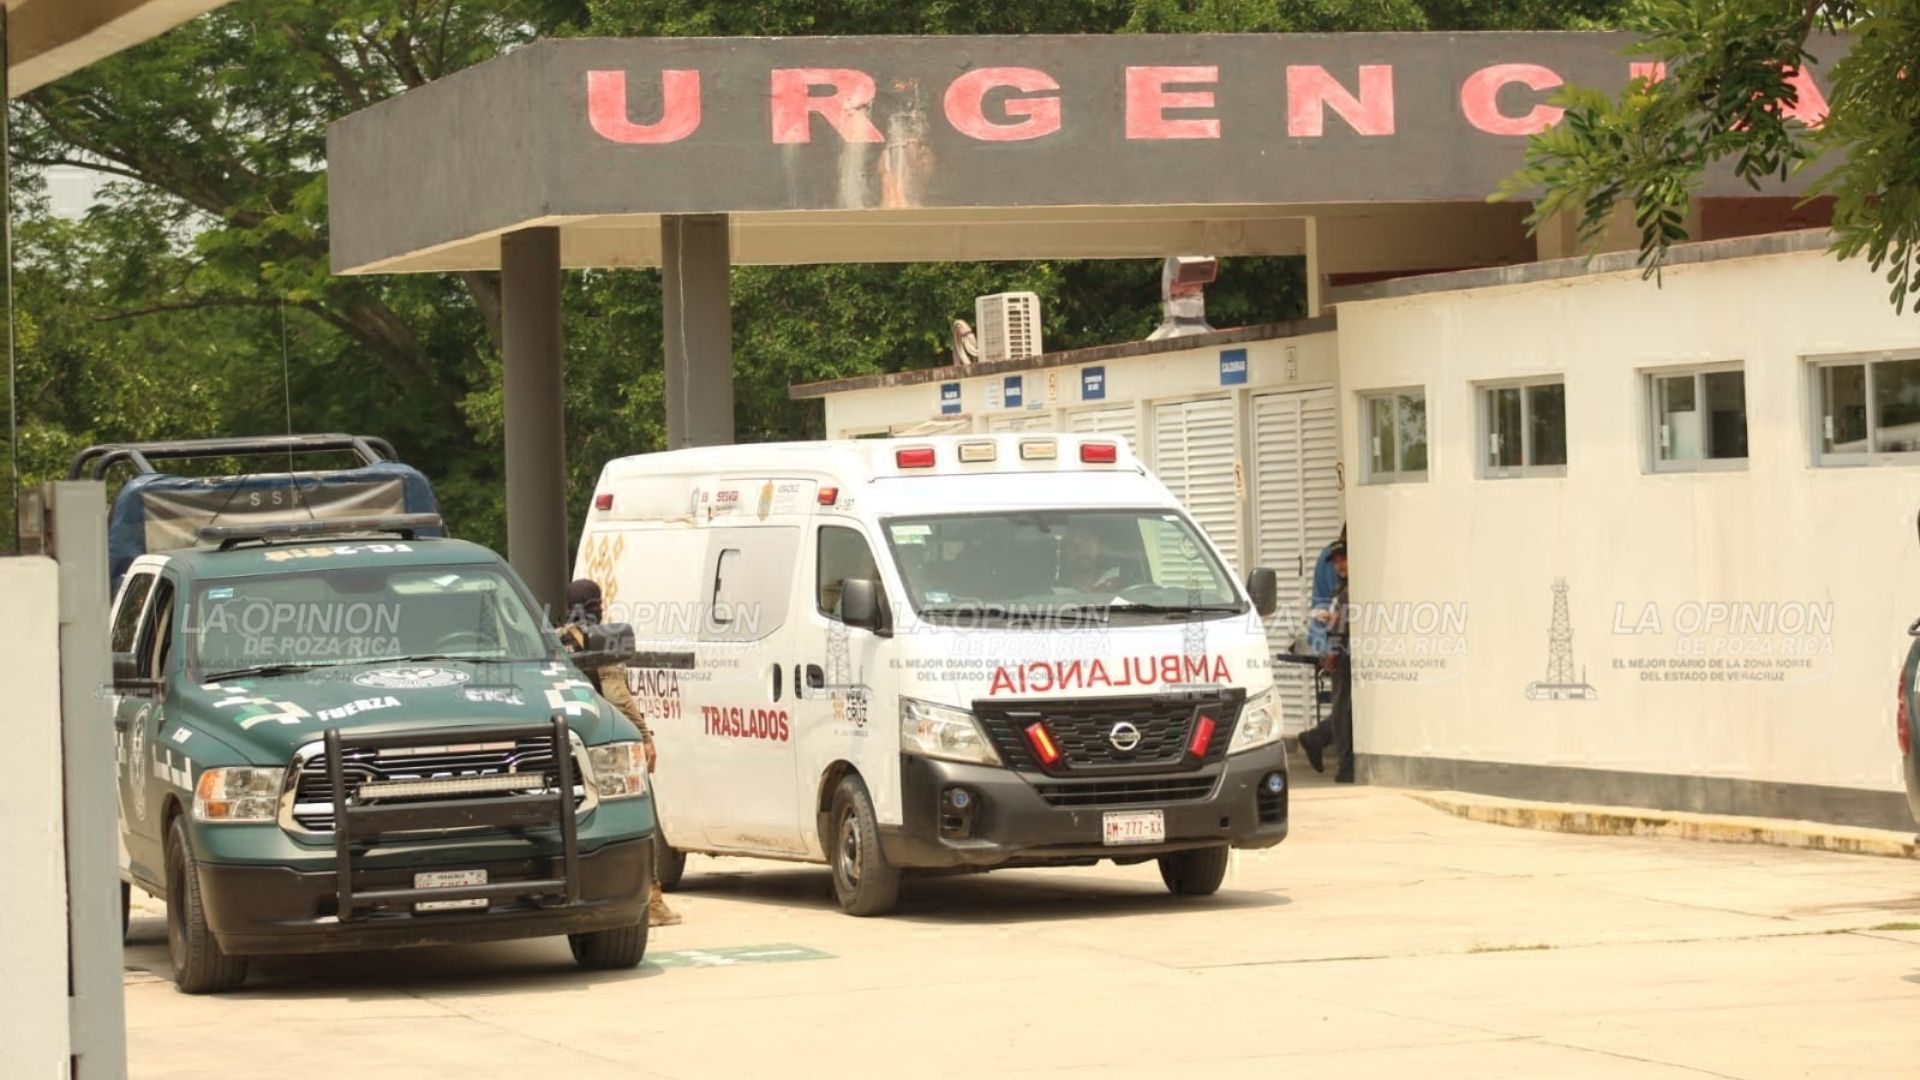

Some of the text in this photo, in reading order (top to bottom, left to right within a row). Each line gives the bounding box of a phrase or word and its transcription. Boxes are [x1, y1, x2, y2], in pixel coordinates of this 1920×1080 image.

[316, 696, 402, 721] FUERZA
[663, 699, 682, 720] 911
[701, 705, 790, 742] TRASLADOS
